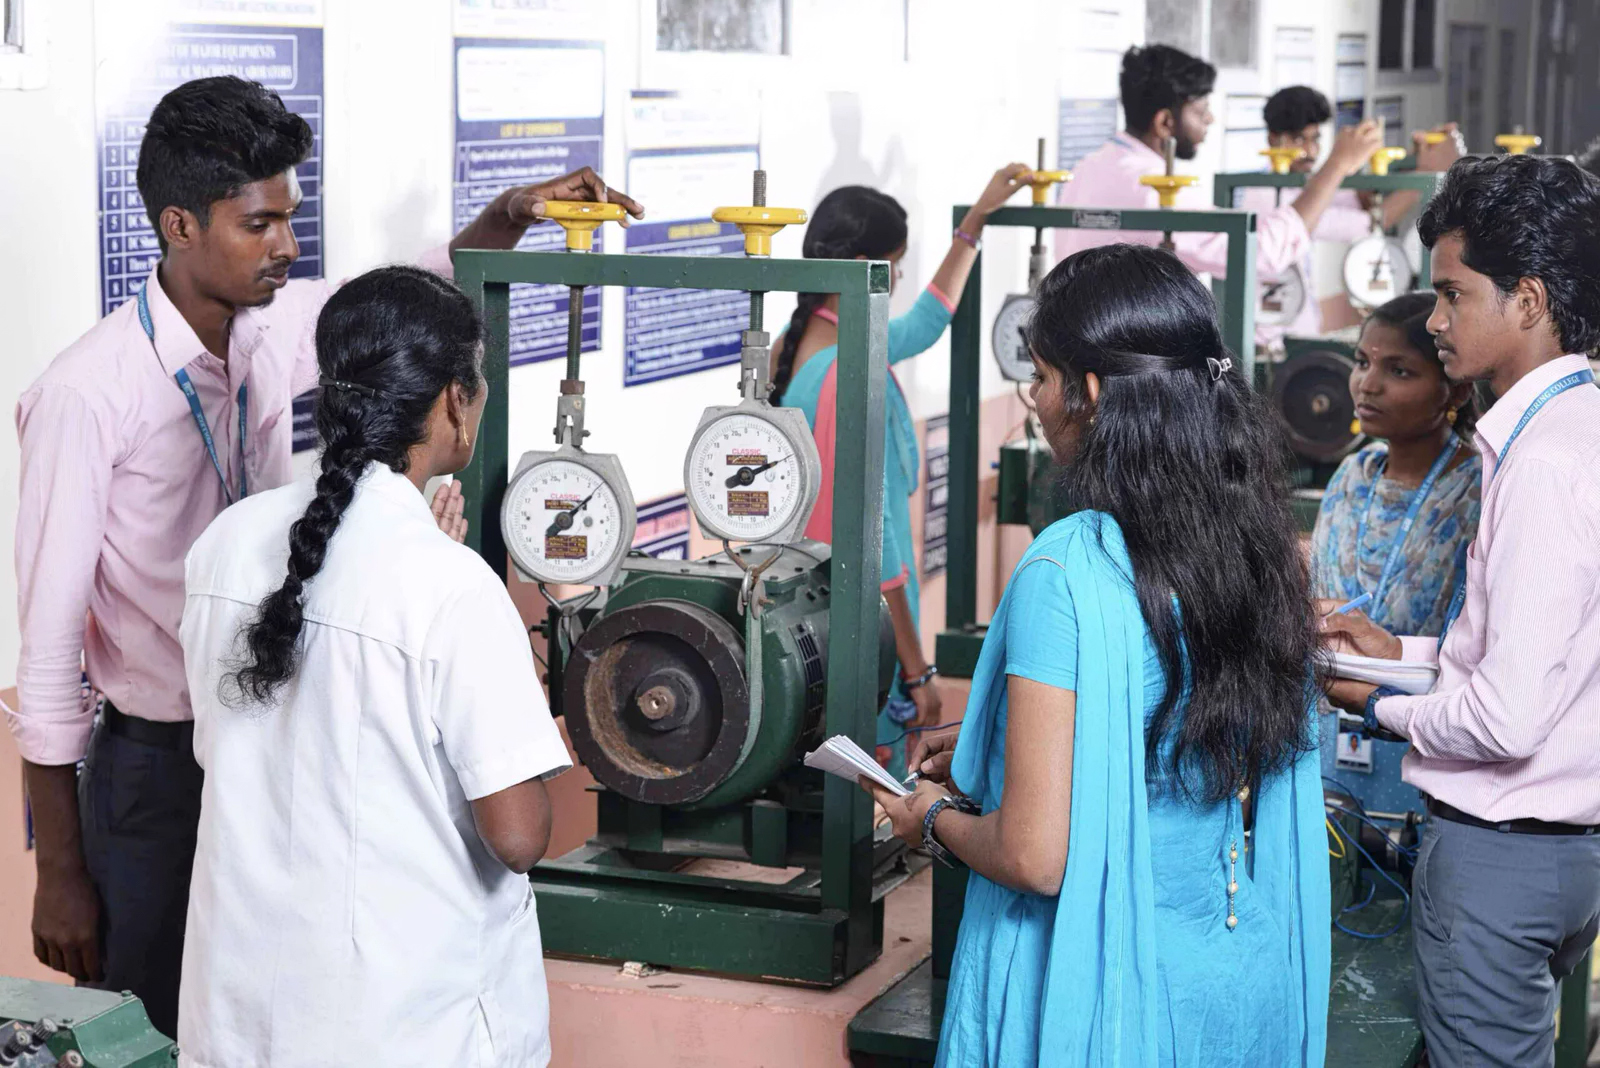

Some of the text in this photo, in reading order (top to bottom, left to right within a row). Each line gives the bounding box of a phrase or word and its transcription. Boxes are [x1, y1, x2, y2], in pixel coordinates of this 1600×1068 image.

[112, 216, 118, 230] 5
[112, 260, 118, 273] 7
[1551, 374, 1580, 394] COLLEGE
